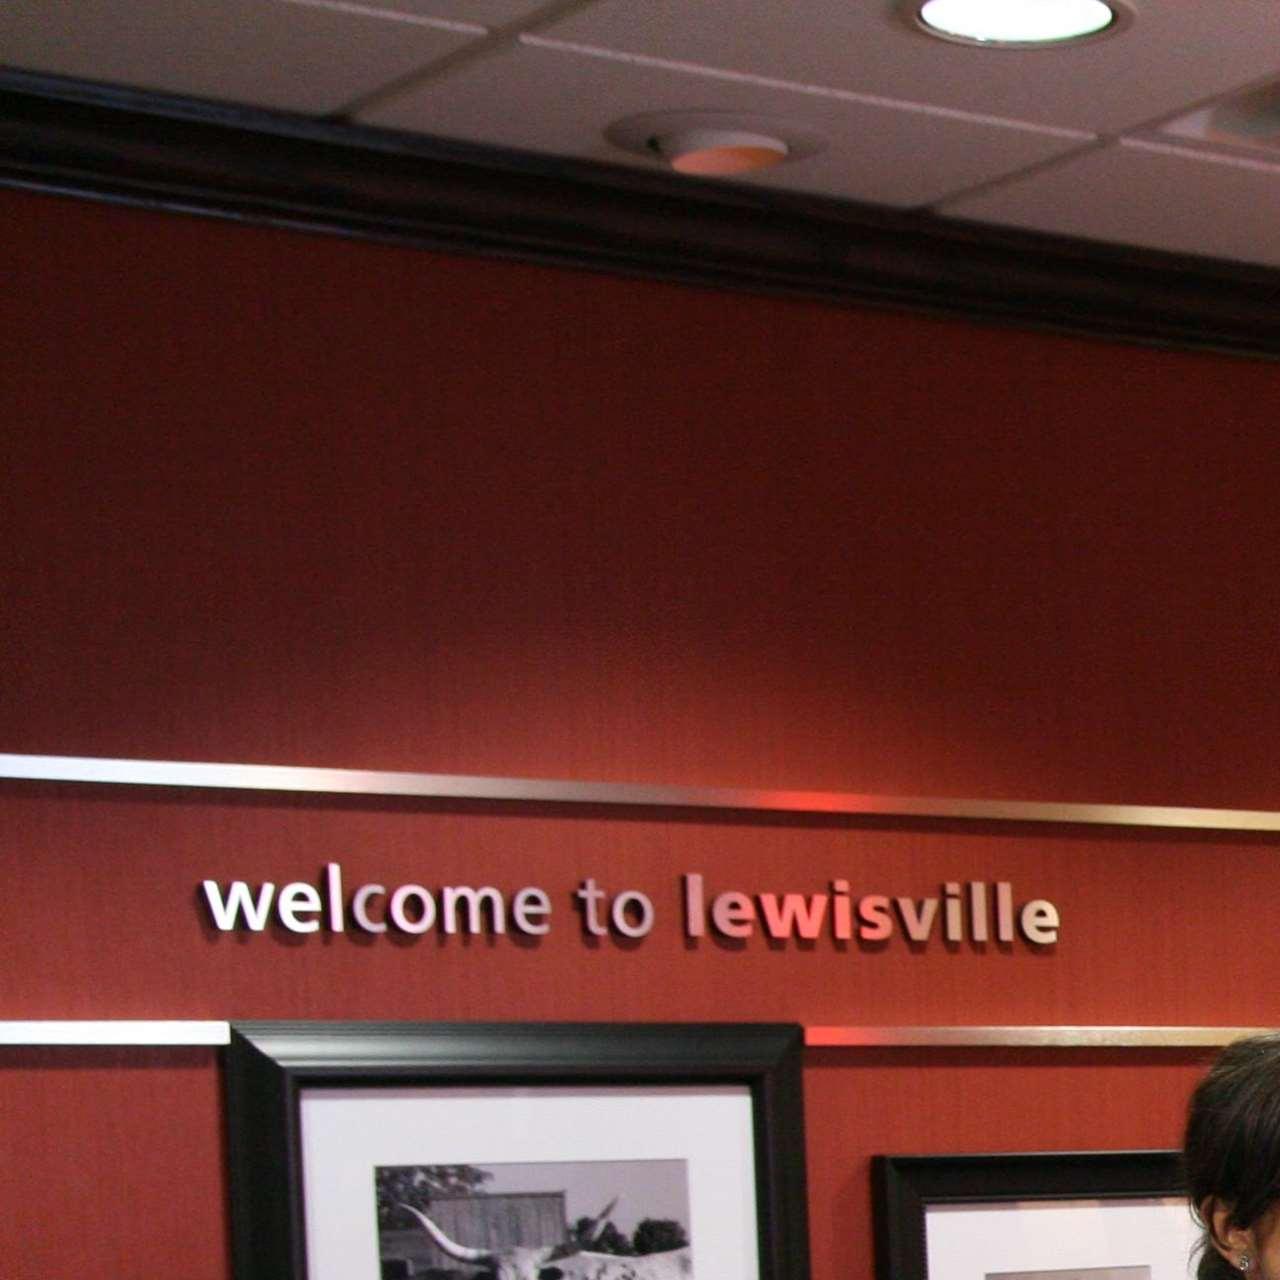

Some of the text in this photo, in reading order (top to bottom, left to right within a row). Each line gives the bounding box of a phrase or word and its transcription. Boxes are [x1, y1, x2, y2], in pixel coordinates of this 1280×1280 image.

[202, 861, 1061, 945] welcome to lewisville
